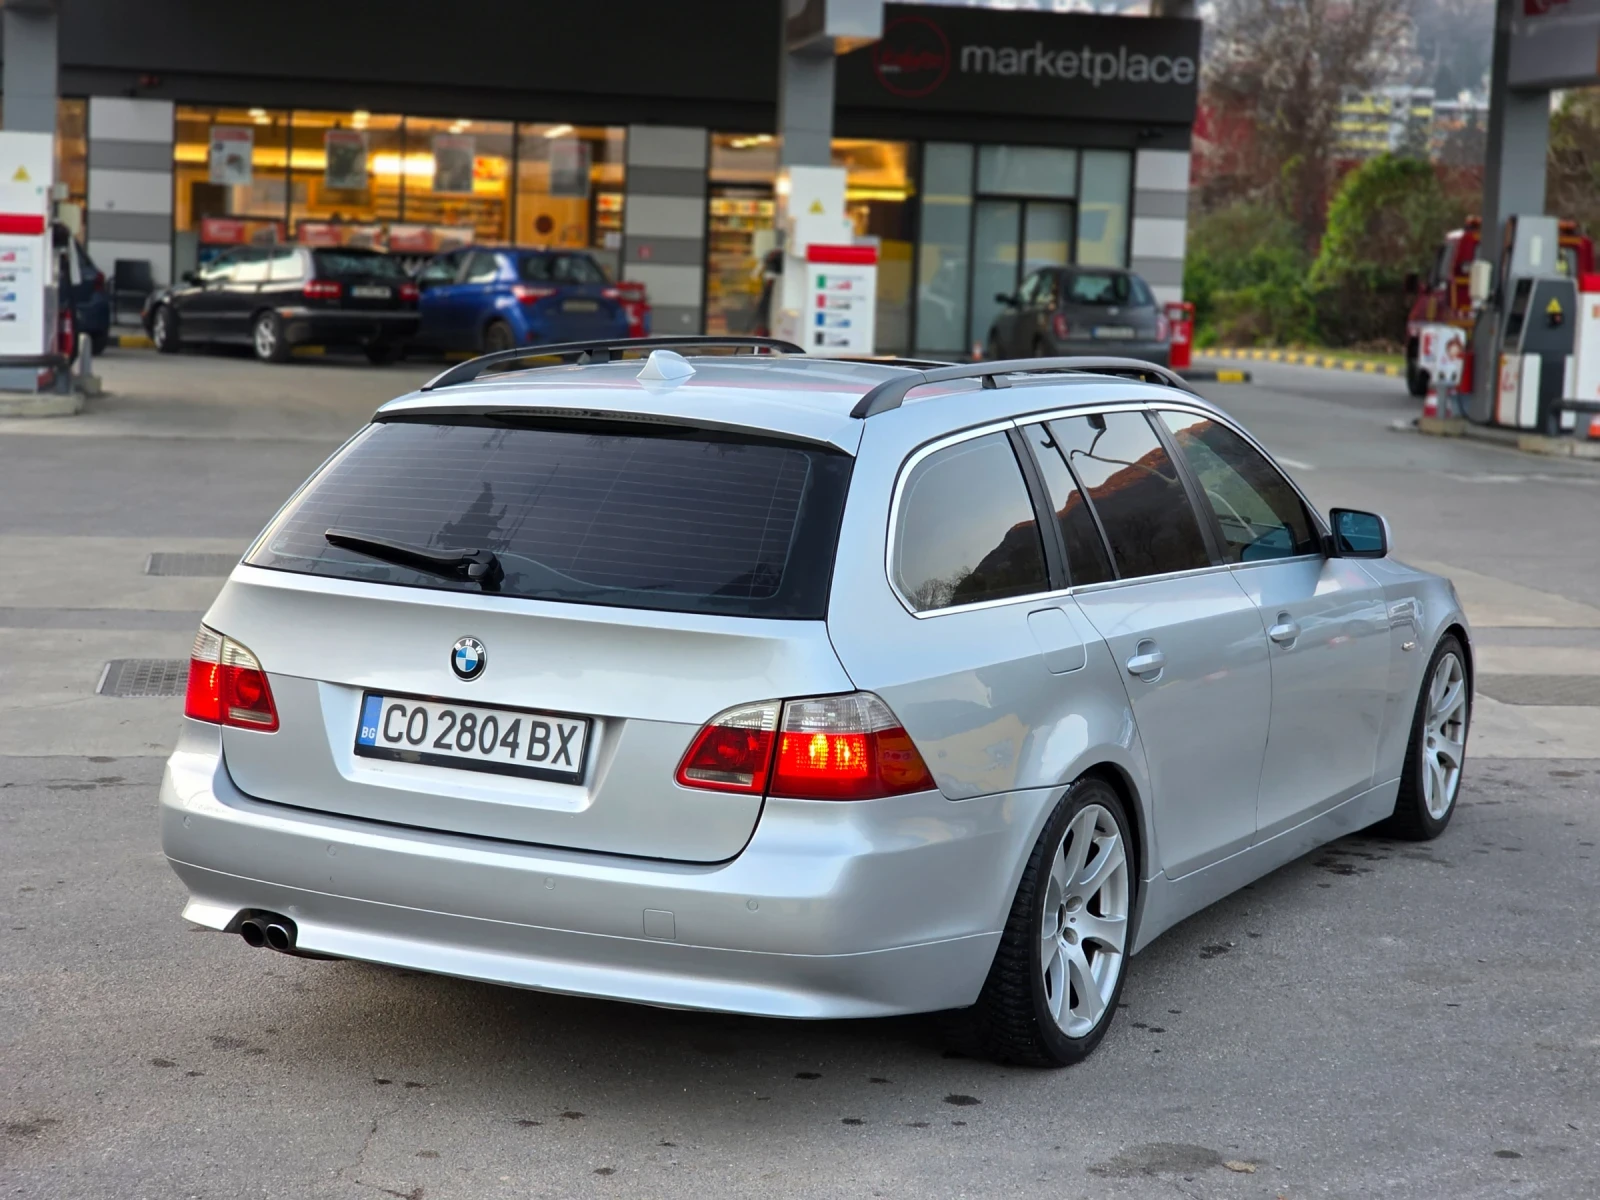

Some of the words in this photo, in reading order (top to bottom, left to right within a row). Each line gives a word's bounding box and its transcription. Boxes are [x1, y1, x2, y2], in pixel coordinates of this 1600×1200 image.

[960, 42, 1196, 87] marketplace
[454, 639, 484, 654] BMW
[361, 726, 376, 739] BG
[433, 710, 522, 759] 2804
